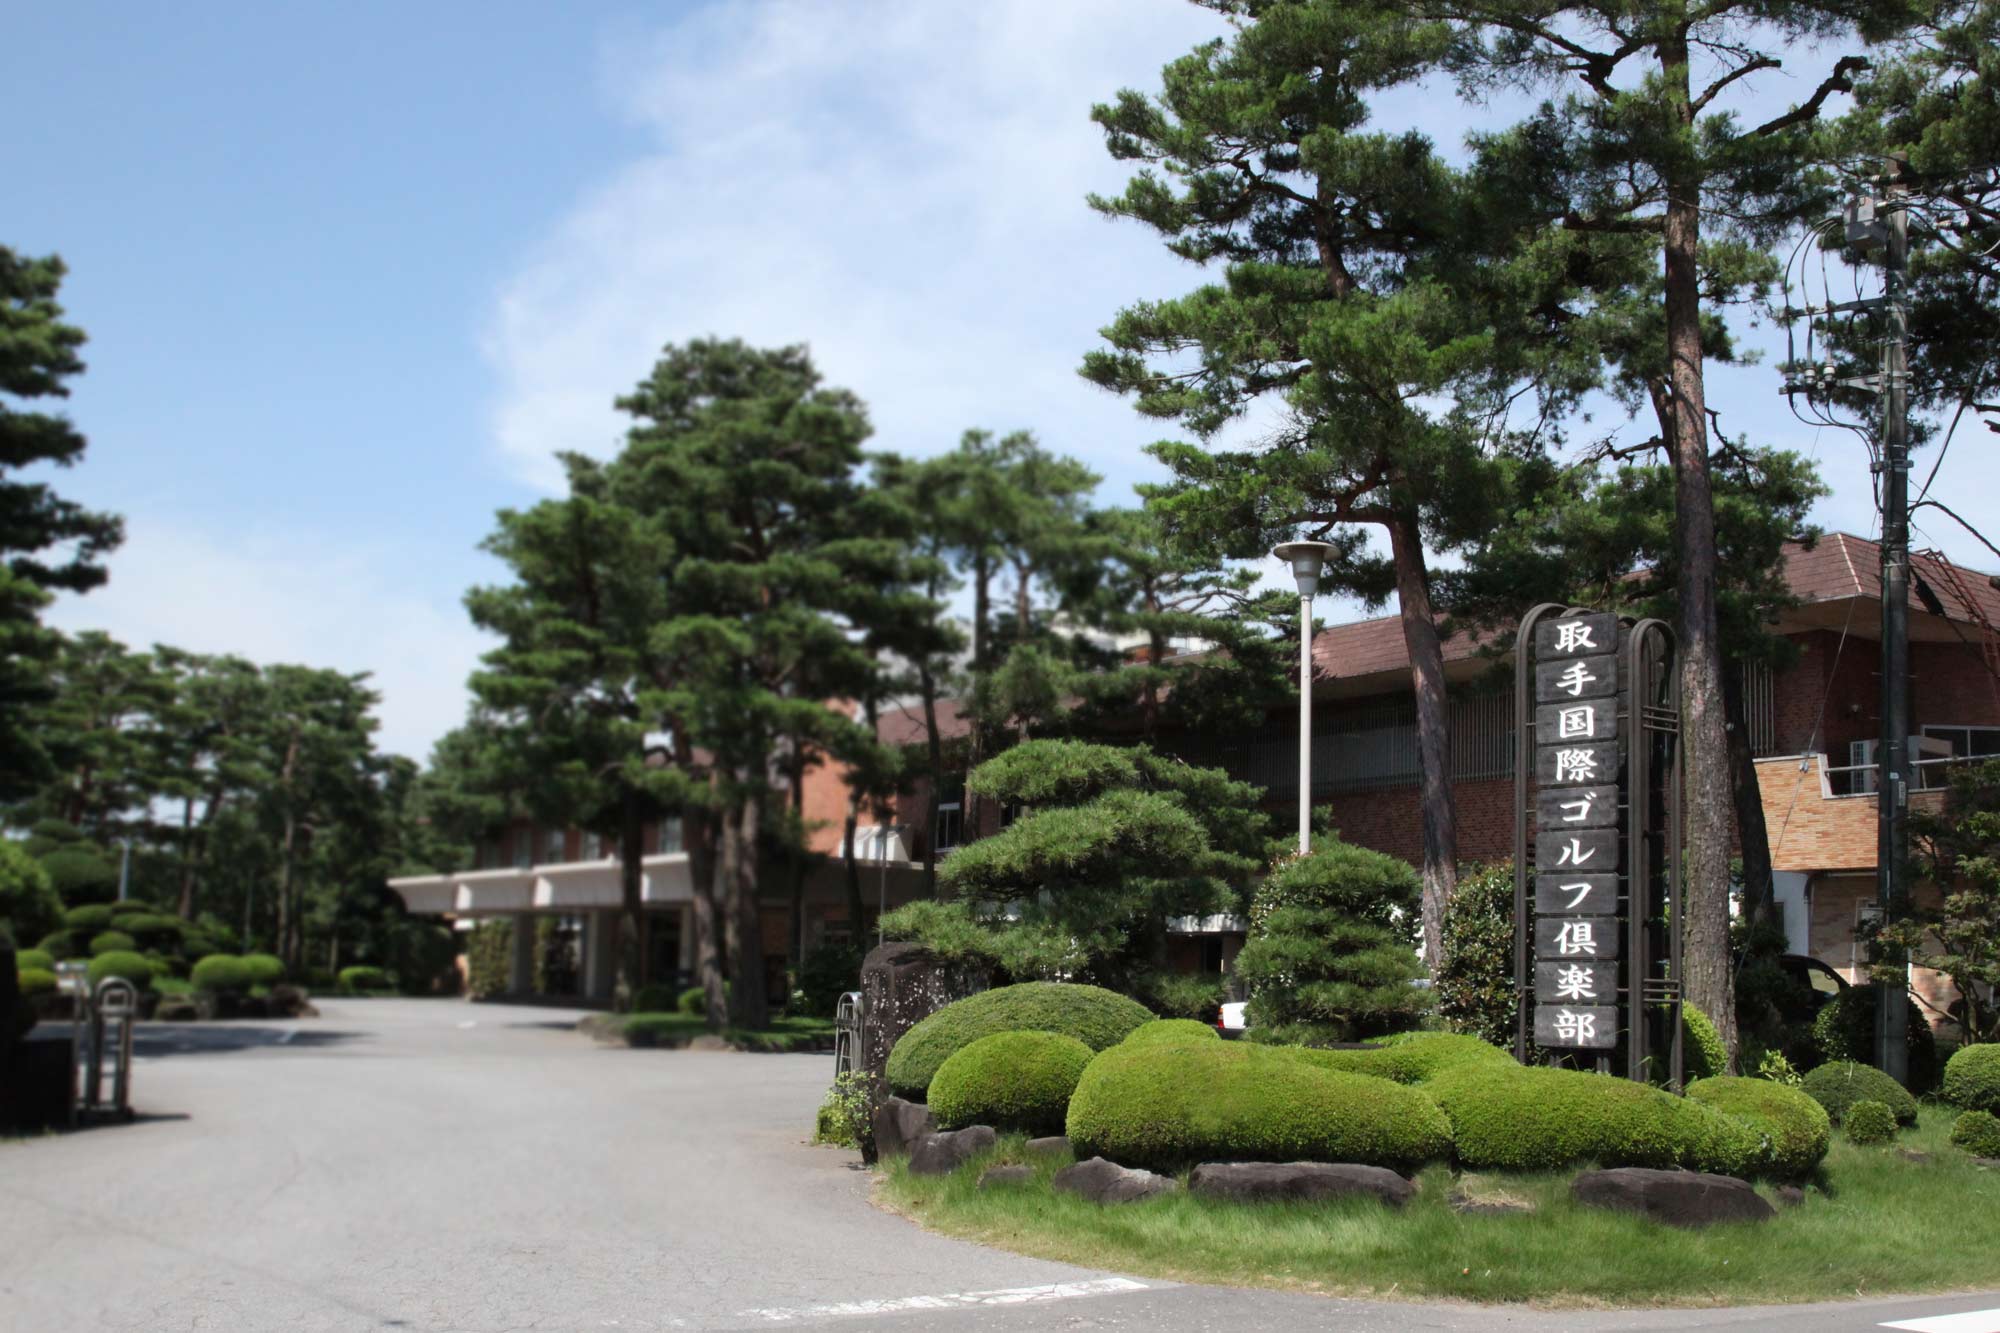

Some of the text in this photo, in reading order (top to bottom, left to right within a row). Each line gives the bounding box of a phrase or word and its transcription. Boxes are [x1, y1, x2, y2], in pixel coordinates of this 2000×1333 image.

[1553, 620, 1598, 1046] 取手国際ゴルフ倶楽部
